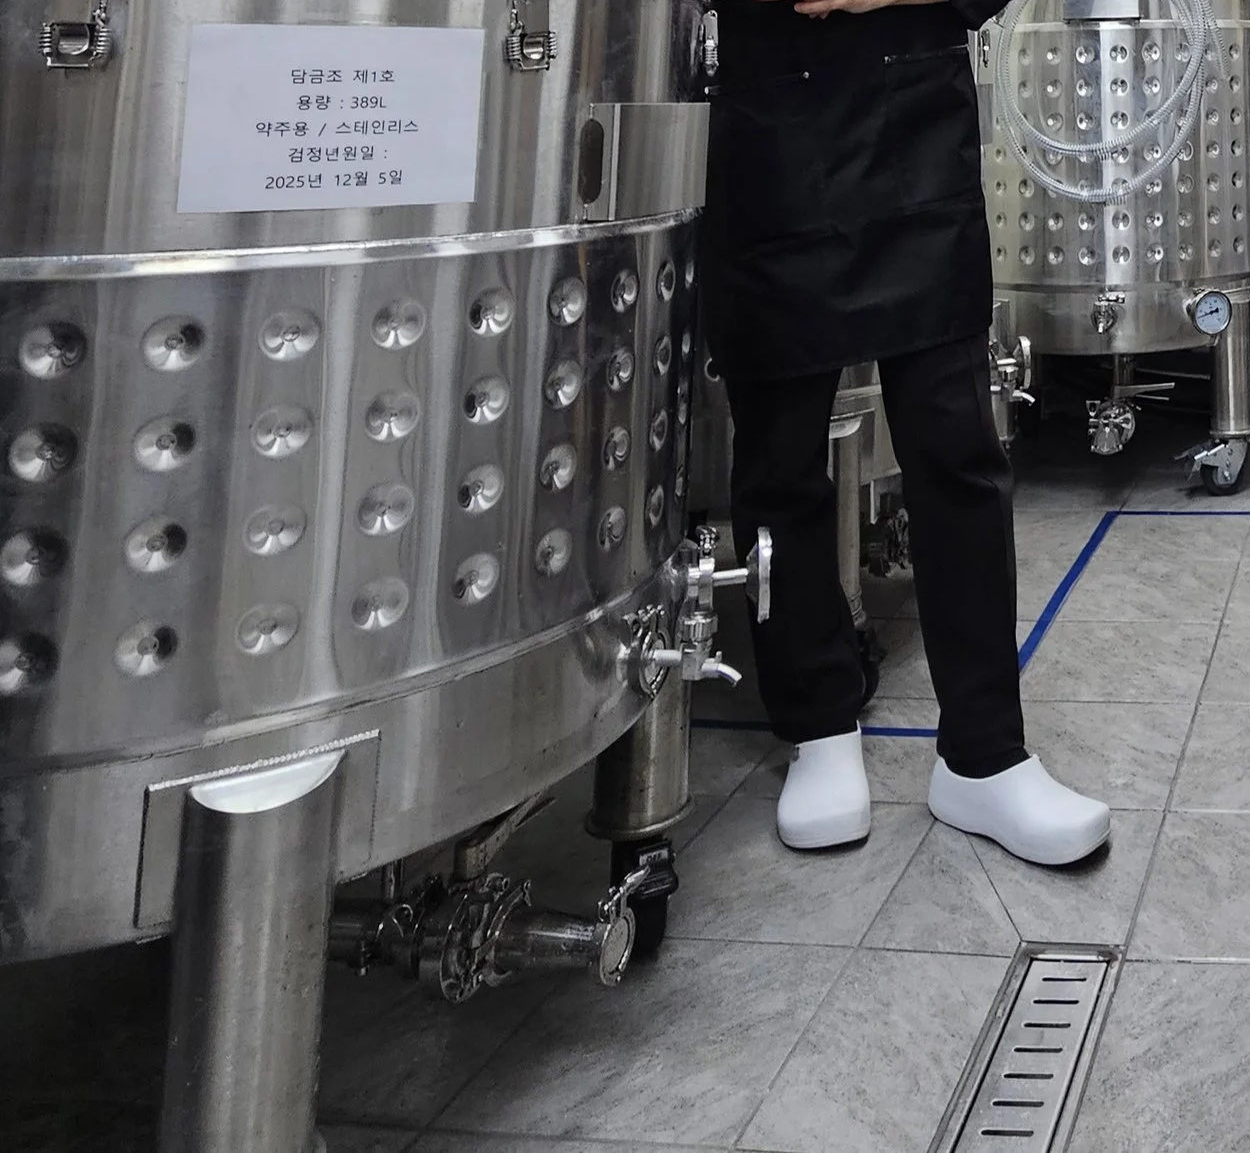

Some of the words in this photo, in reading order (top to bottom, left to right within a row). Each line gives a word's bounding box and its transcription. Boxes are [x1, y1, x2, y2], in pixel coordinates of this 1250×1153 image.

[291, 68, 343, 85] 담금조
[352, 69, 395, 84] 제1호
[296, 94, 332, 111] 용량
[350, 95, 387, 110] 389L
[255, 121, 310, 138] 약주용
[318, 123, 326, 137] /
[335, 119, 419, 135] 스테인리스
[264, 173, 322, 190] 2025년
[334, 170, 369, 187] 12월
[378, 169, 403, 186] 5일
